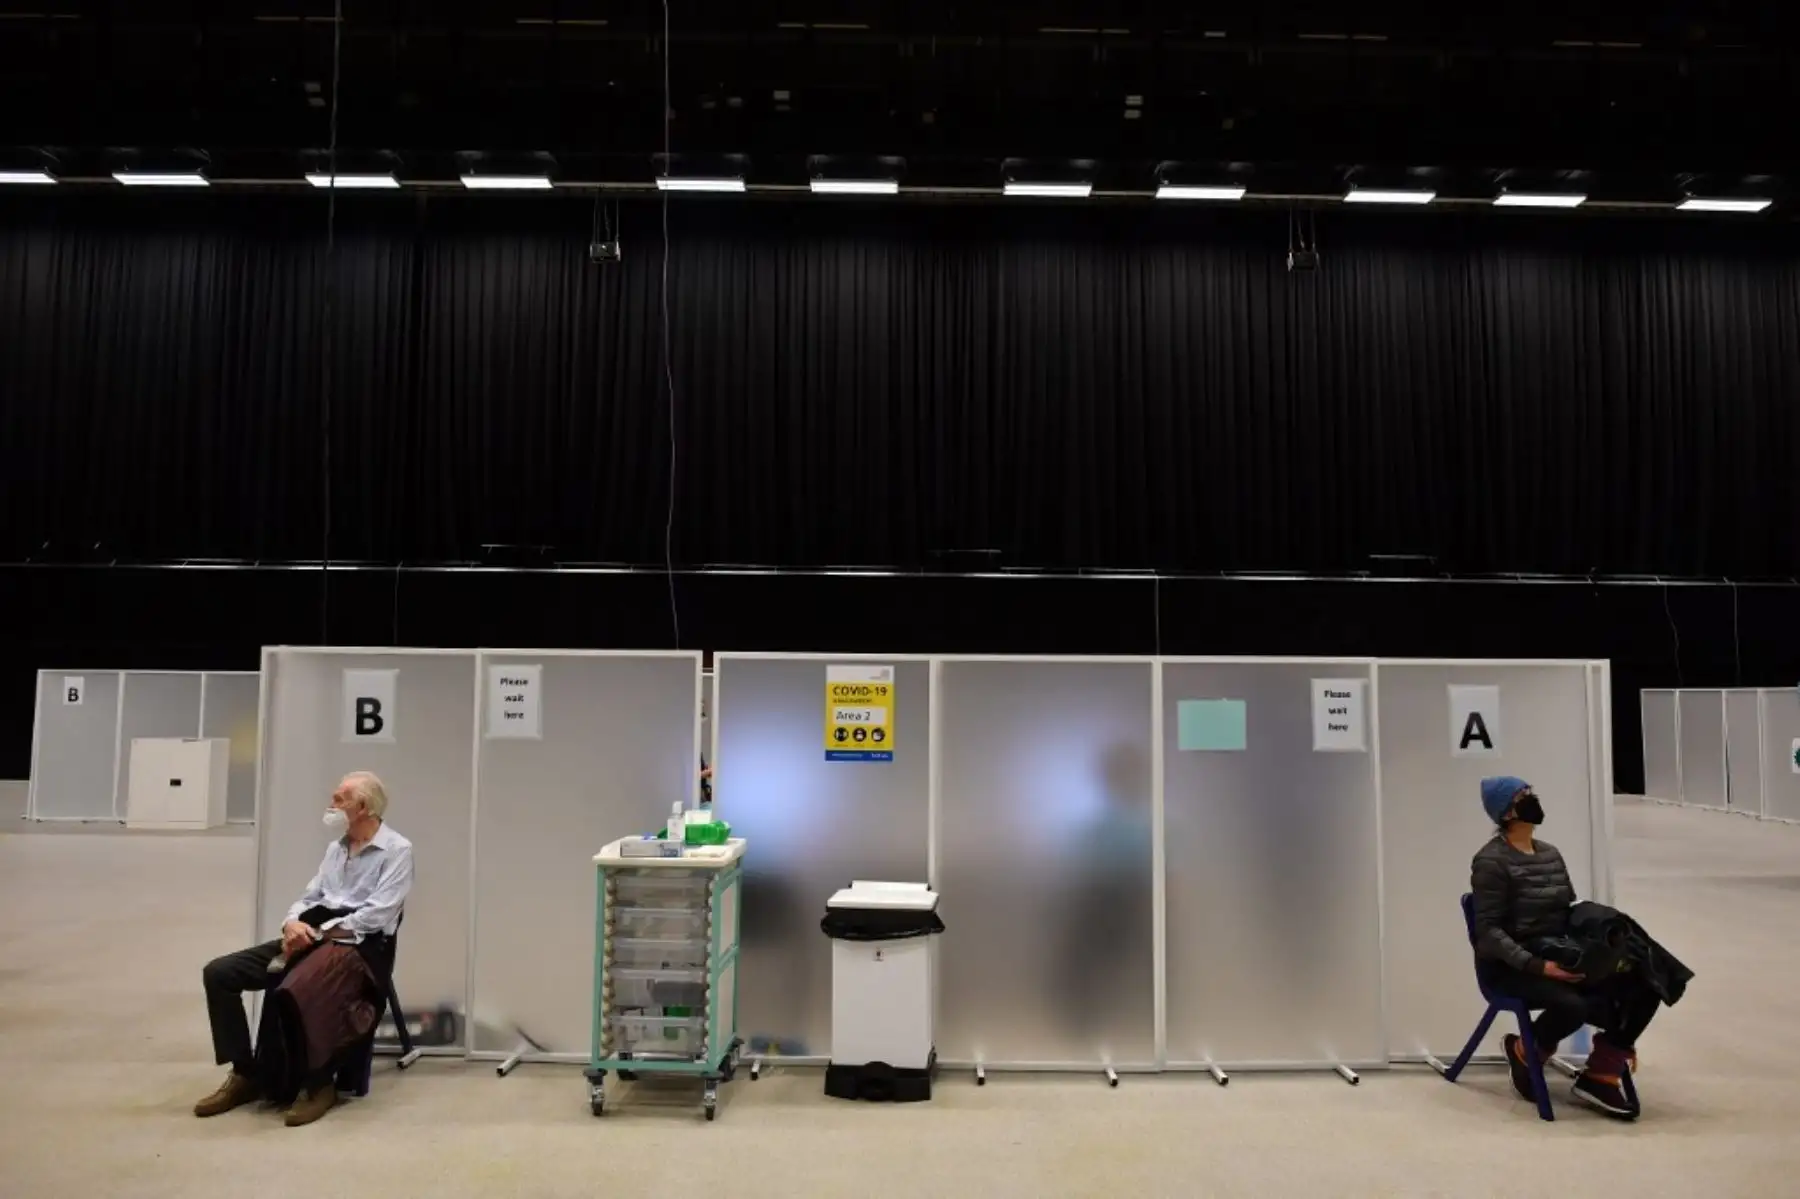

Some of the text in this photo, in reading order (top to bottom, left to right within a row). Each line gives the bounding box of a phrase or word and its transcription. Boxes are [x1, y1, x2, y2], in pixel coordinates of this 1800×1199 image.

[500, 677, 529, 686] Please
[68, 687, 80, 702] B
[832, 685, 888, 697] COVID-19
[1324, 690, 1352, 699] Please
[504, 694, 525, 703] wait
[1328, 706, 1348, 715] wait
[355, 697, 384, 735] B
[504, 711, 525, 720] here
[836, 711, 862, 721] Area
[1328, 723, 1349, 732] here
[1459, 711, 1493, 750] A
